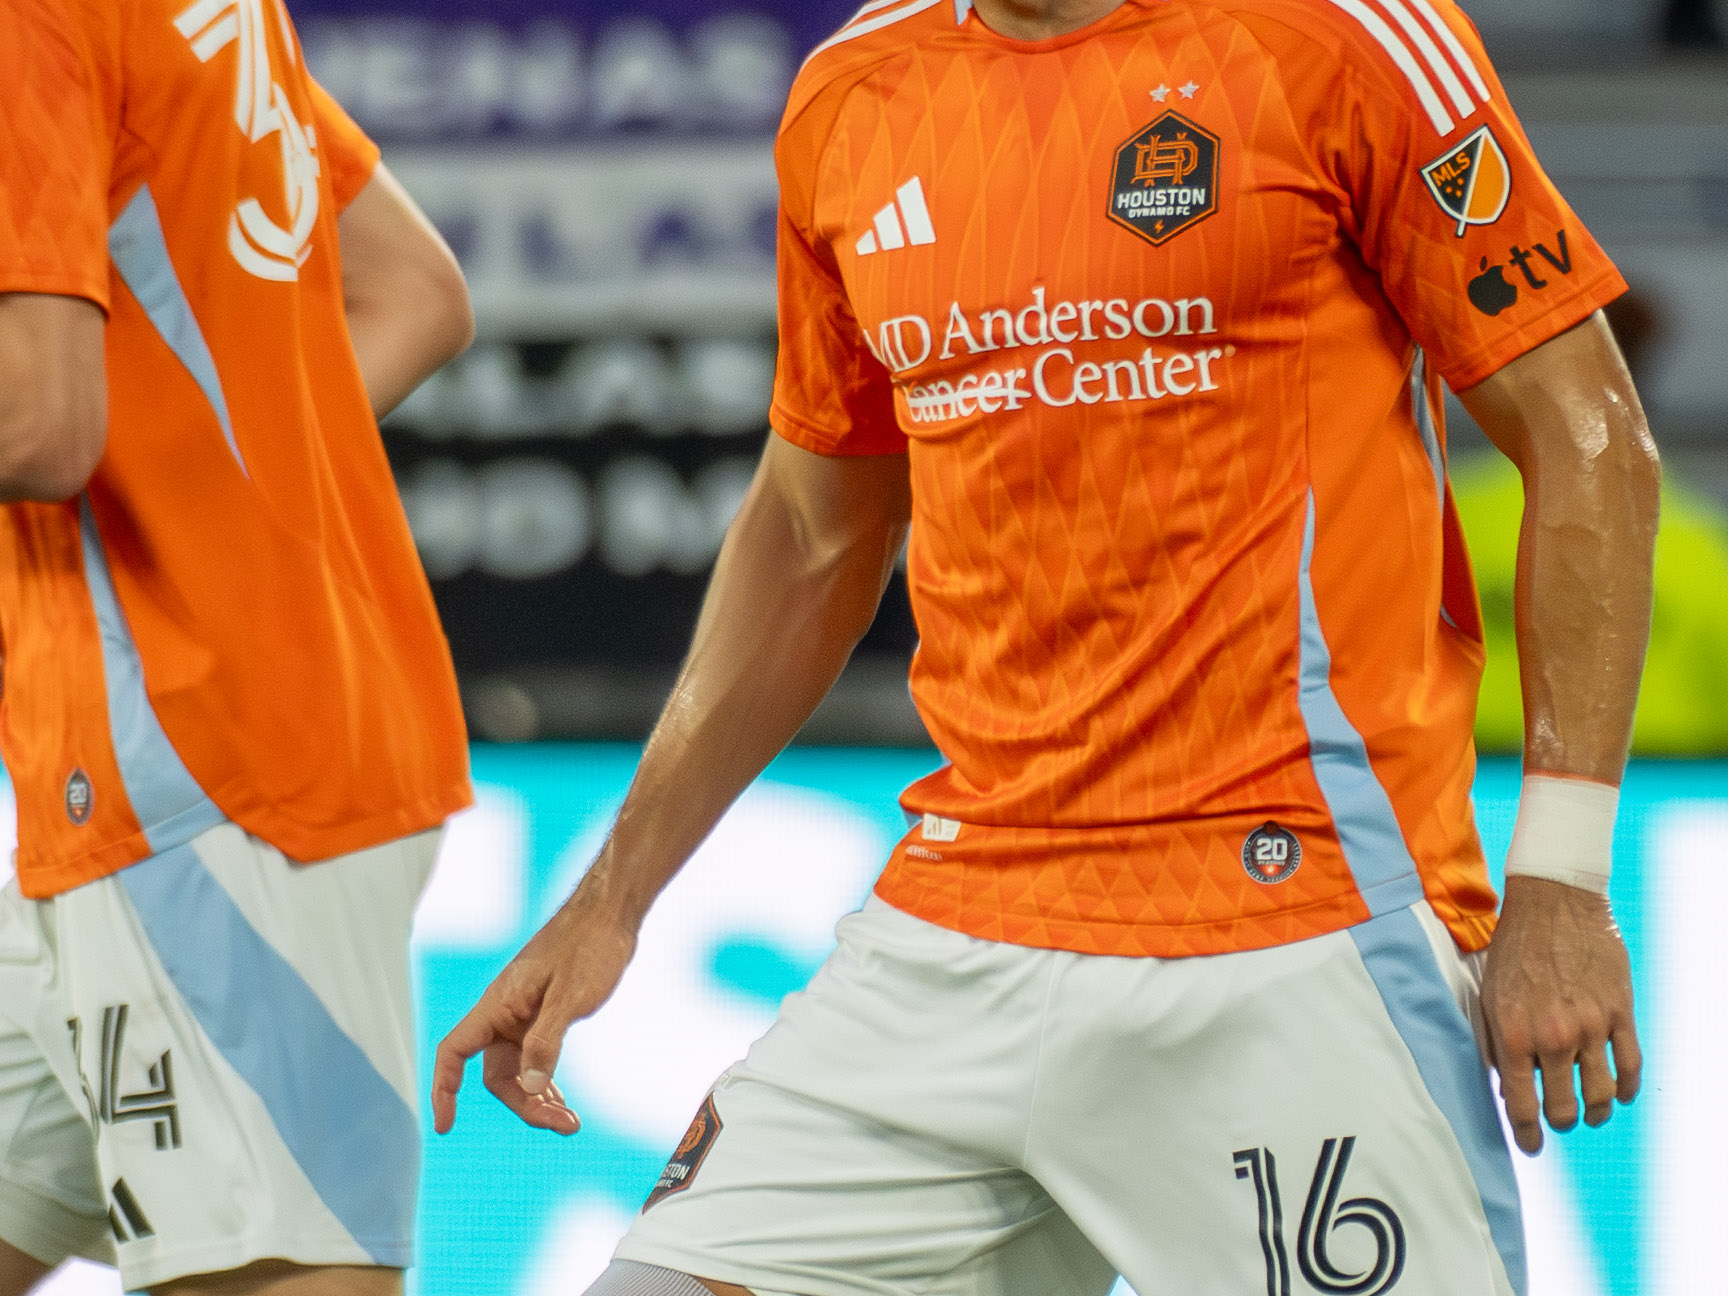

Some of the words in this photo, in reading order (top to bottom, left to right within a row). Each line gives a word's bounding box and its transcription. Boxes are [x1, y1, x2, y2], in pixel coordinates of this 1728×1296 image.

[1431, 152, 1471, 187] MLS
[1117, 188, 1206, 209] HOUSTON
[1128, 207, 1174, 218] DYNAMO
[1176, 206, 1190, 216] FC
[1509, 229, 1571, 290] tv
[863, 314, 931, 373] MD
[939, 286, 1218, 360] Anderson
[1033, 347, 1222, 407] Center
[1256, 837, 1288, 860] 20
